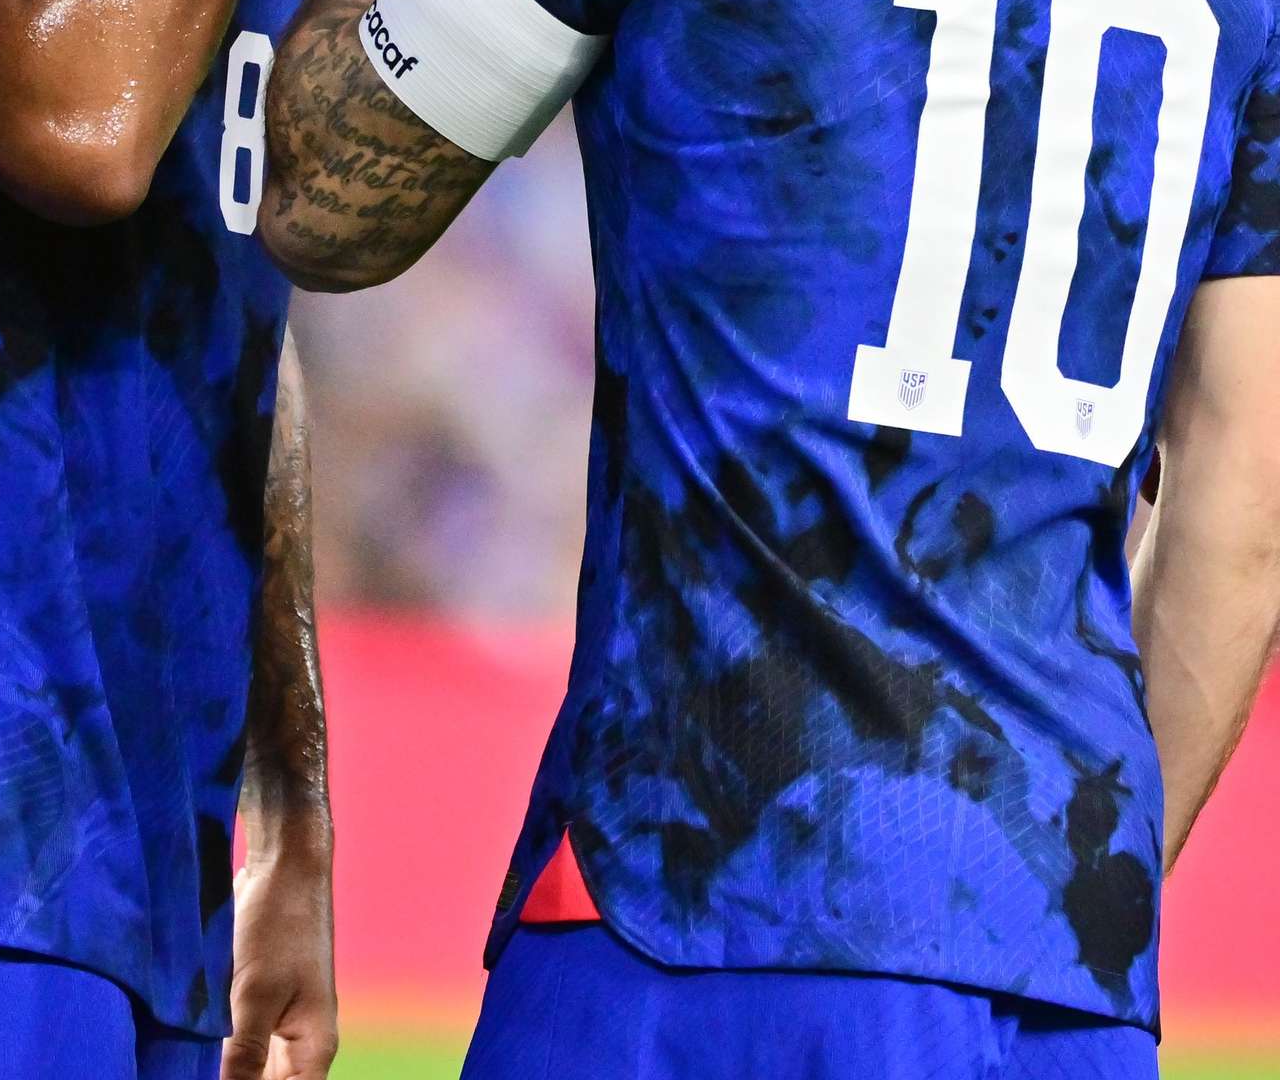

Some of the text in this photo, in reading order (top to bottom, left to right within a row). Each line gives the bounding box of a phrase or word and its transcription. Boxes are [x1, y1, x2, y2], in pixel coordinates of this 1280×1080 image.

[219, 30, 275, 236] 8
[903, 372, 926, 388] USA
[1077, 401, 1093, 417] USA
